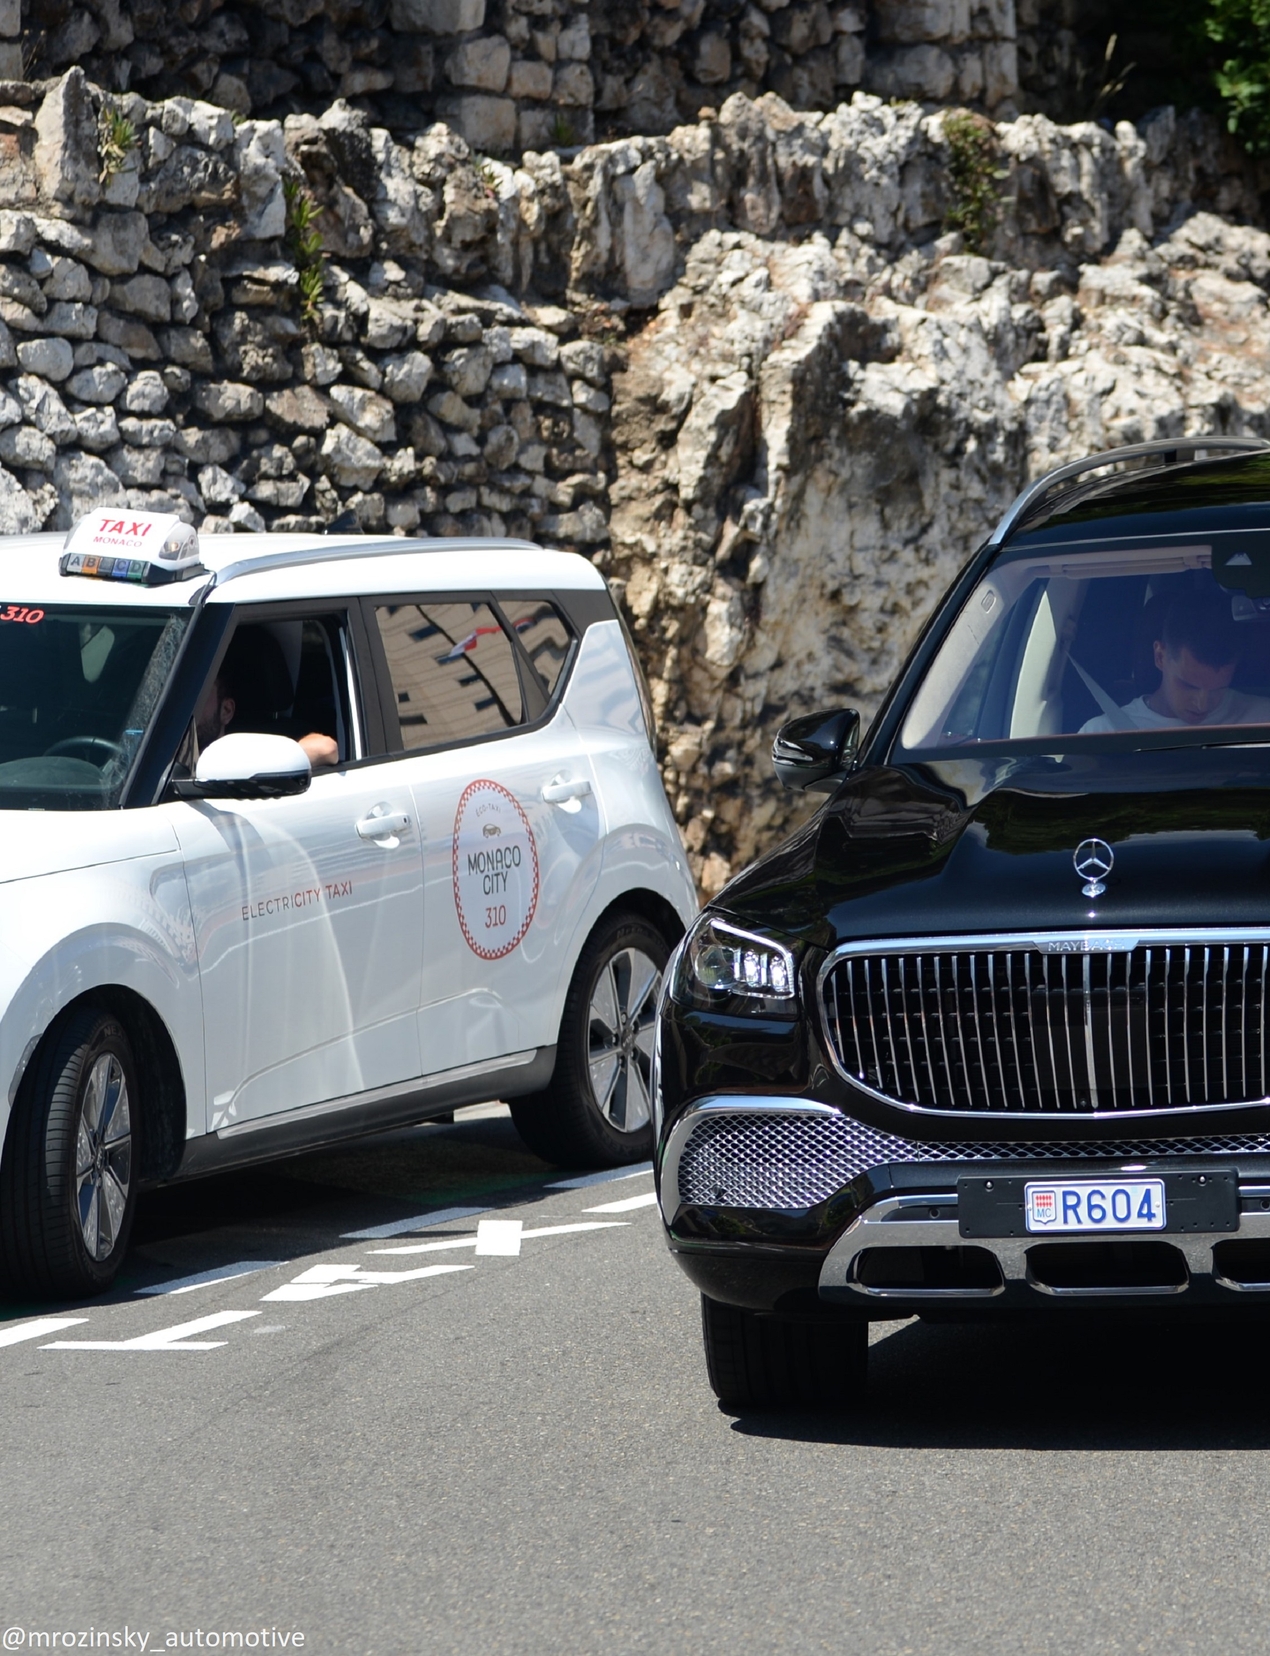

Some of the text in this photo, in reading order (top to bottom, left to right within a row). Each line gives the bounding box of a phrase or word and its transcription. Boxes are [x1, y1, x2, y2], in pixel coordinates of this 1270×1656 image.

[99, 519, 153, 537] TAXI
[93, 536, 143, 548] MONACO
[70, 556, 142, 573] A B C D
[0, 605, 45, 624] 310
[467, 845, 522, 876] MONACO
[482, 872, 509, 896] CITY
[241, 880, 353, 922] ELECTRICITY TAXI
[484, 905, 507, 929] 310
[1036, 1208, 1052, 1218] MC
[1062, 1188, 1157, 1225] R604
